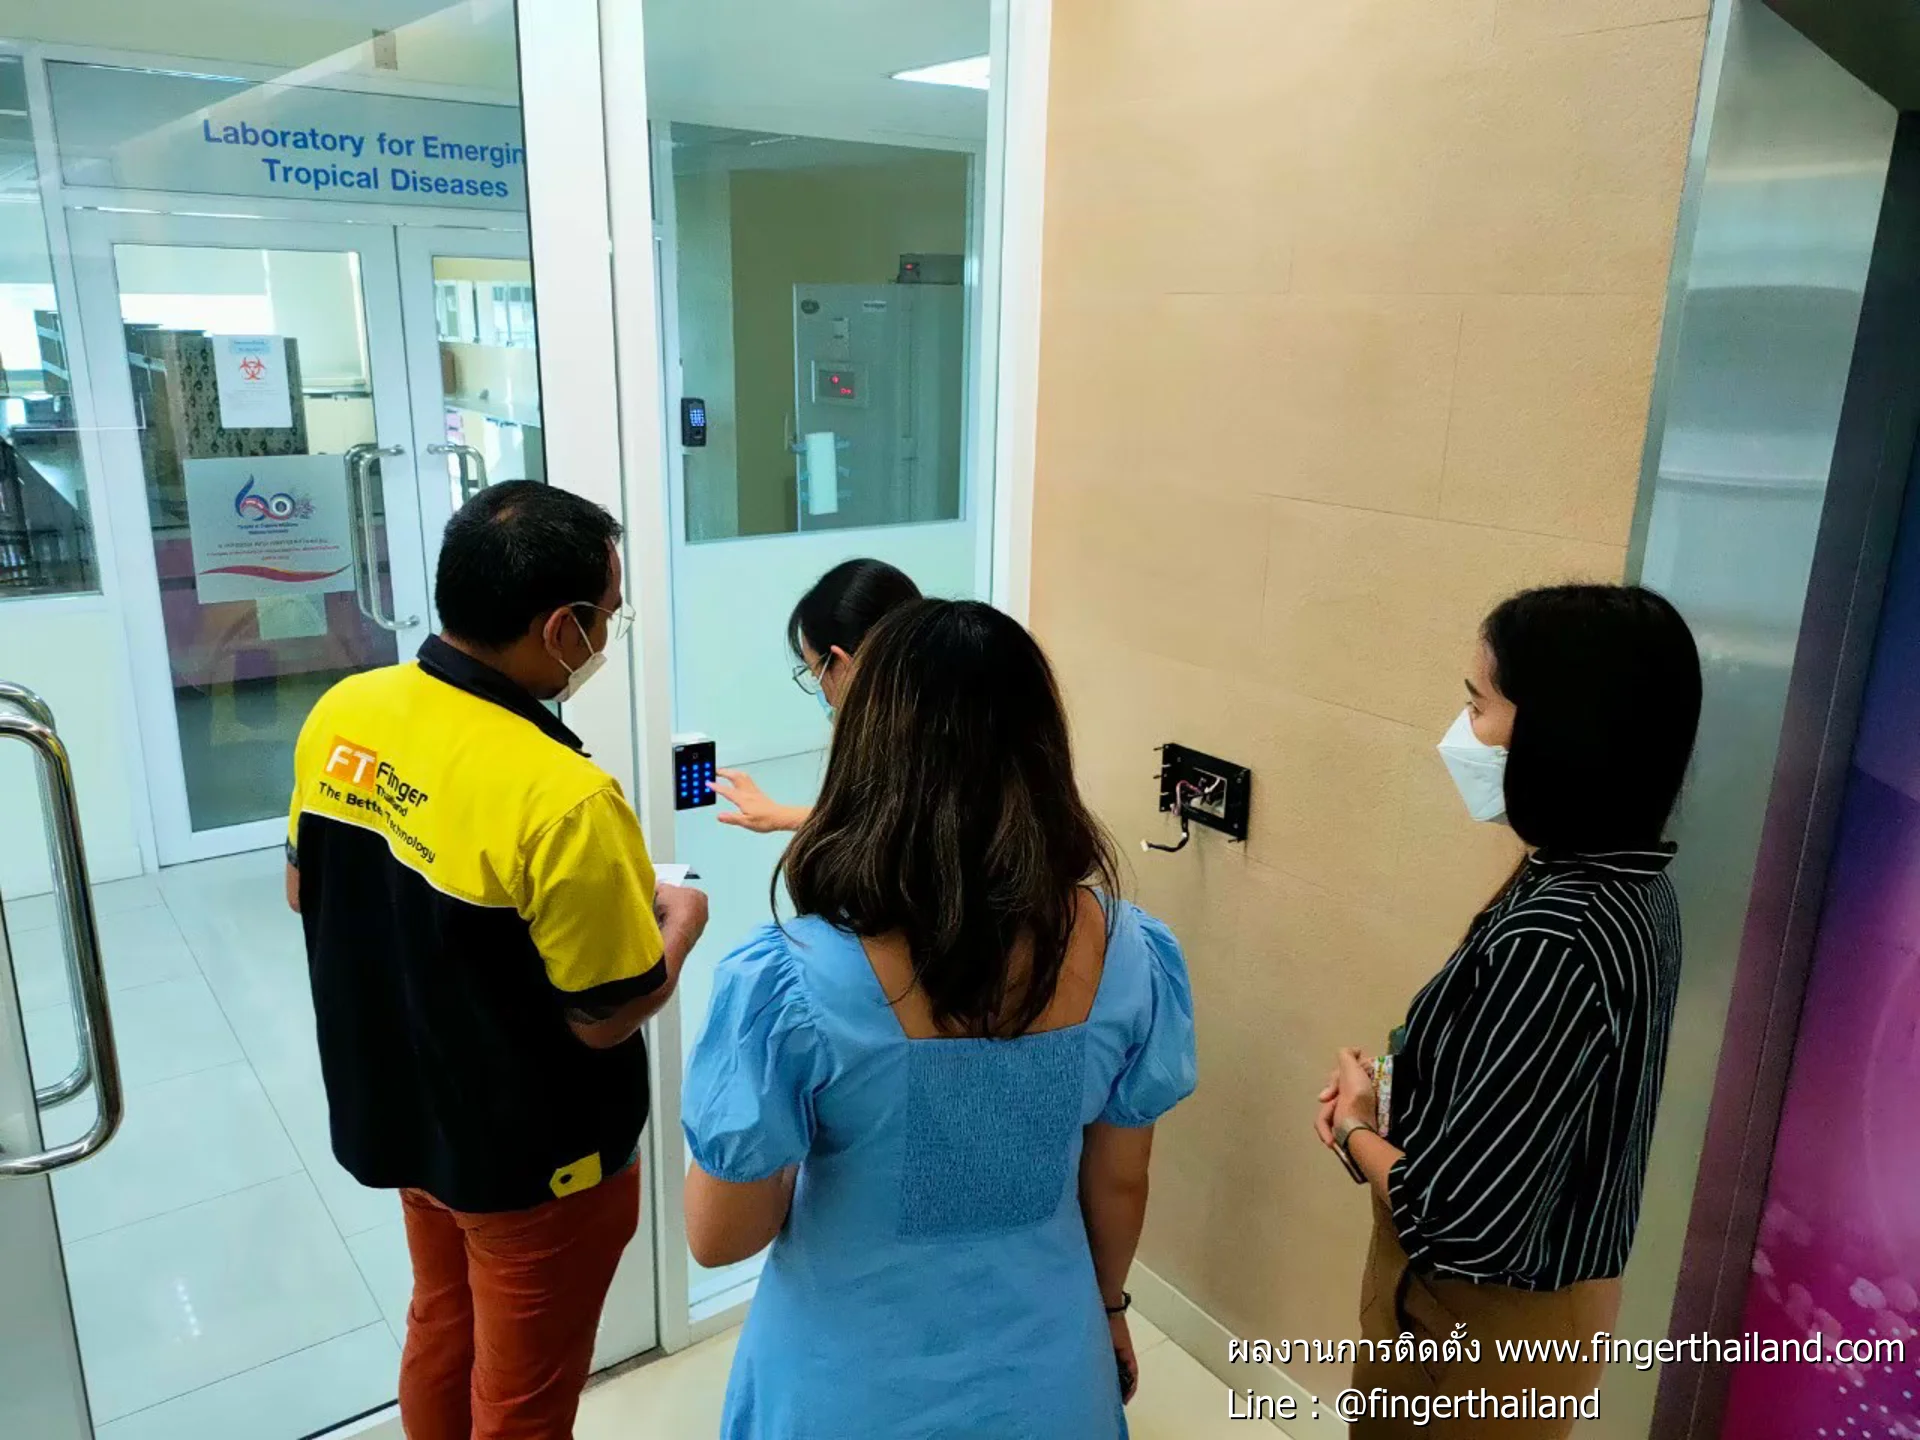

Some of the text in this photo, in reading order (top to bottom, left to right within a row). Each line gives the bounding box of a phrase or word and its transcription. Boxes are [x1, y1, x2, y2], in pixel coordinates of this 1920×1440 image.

[204, 119, 526, 169] Laboratory for Emergin
[262, 158, 509, 198] Tropical Diseases
[325, 744, 376, 784] FT
[376, 761, 429, 807] Finger
[319, 781, 342, 801] The
[345, 792, 384, 816] Bette
[375, 783, 409, 817] Thand
